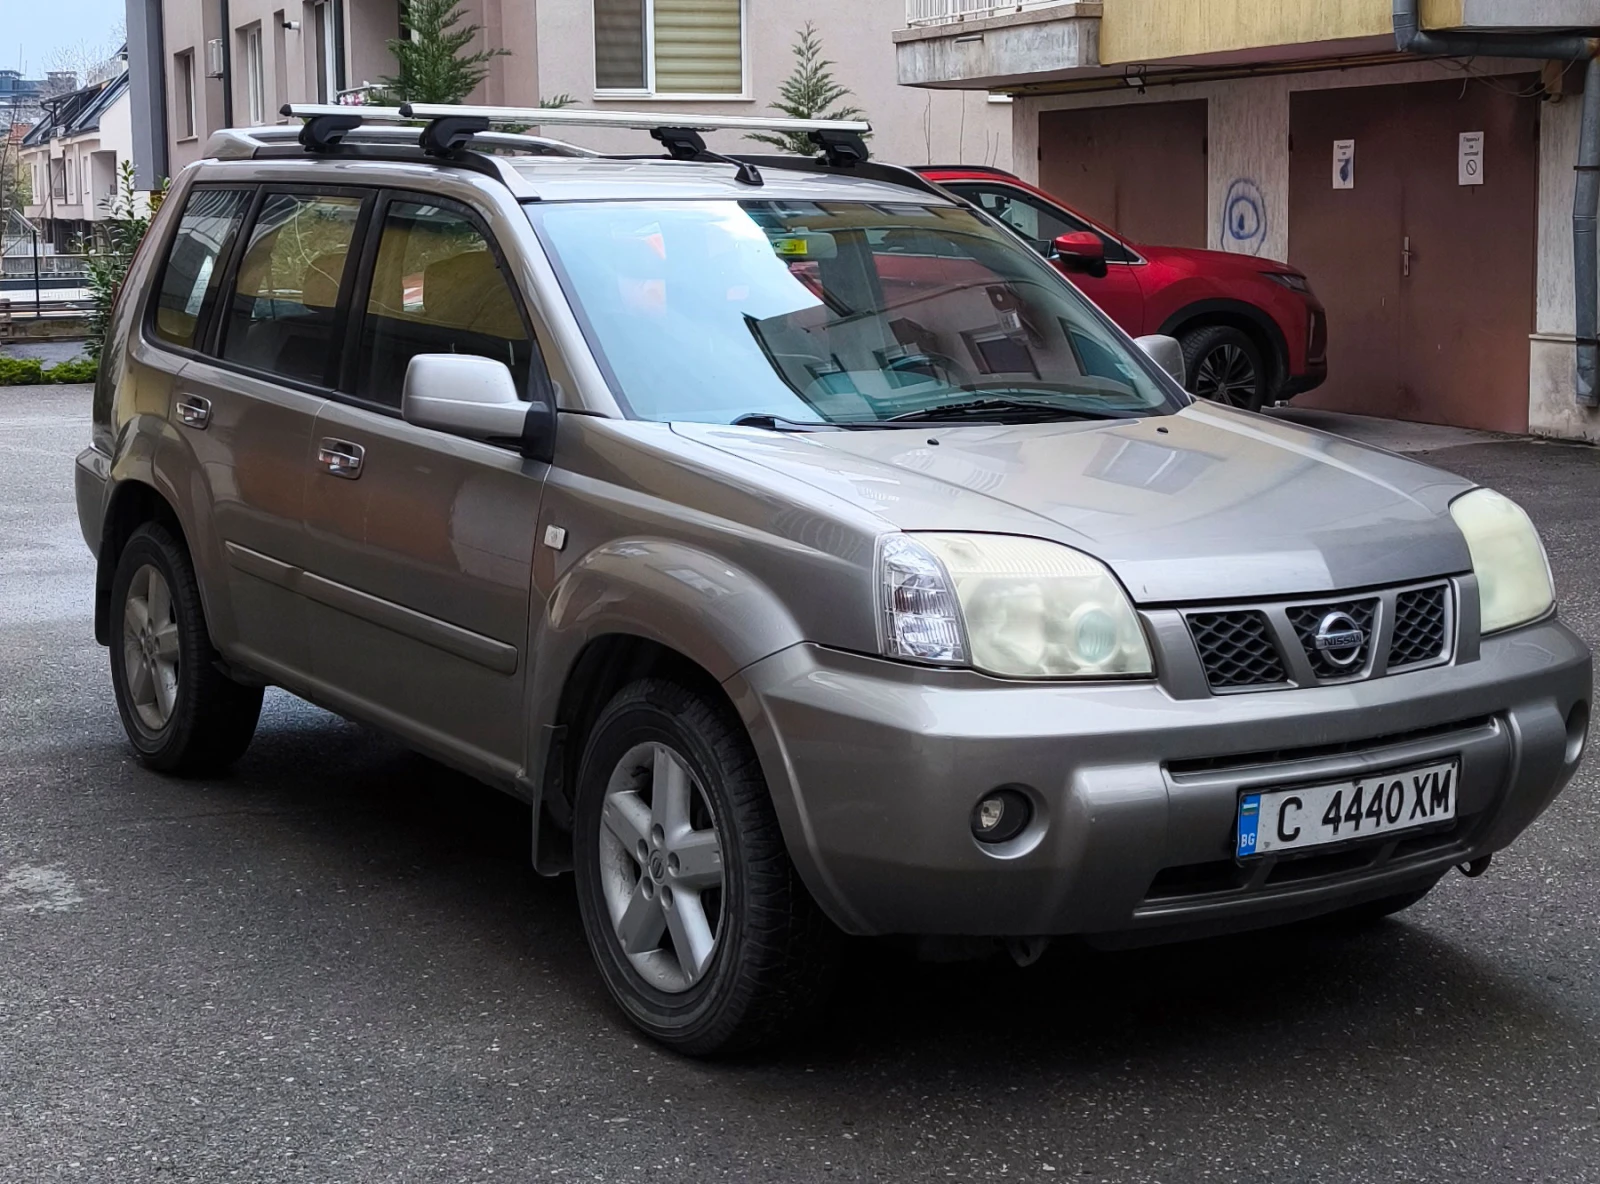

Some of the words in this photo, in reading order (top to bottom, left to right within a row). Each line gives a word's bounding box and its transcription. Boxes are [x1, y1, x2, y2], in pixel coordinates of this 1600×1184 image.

[1324, 632, 1361, 646] NISSAN
[1276, 797, 1303, 842] C
[1321, 780, 1405, 835] 4440
[1409, 769, 1452, 820] XM
[1240, 832, 1256, 848] BG
